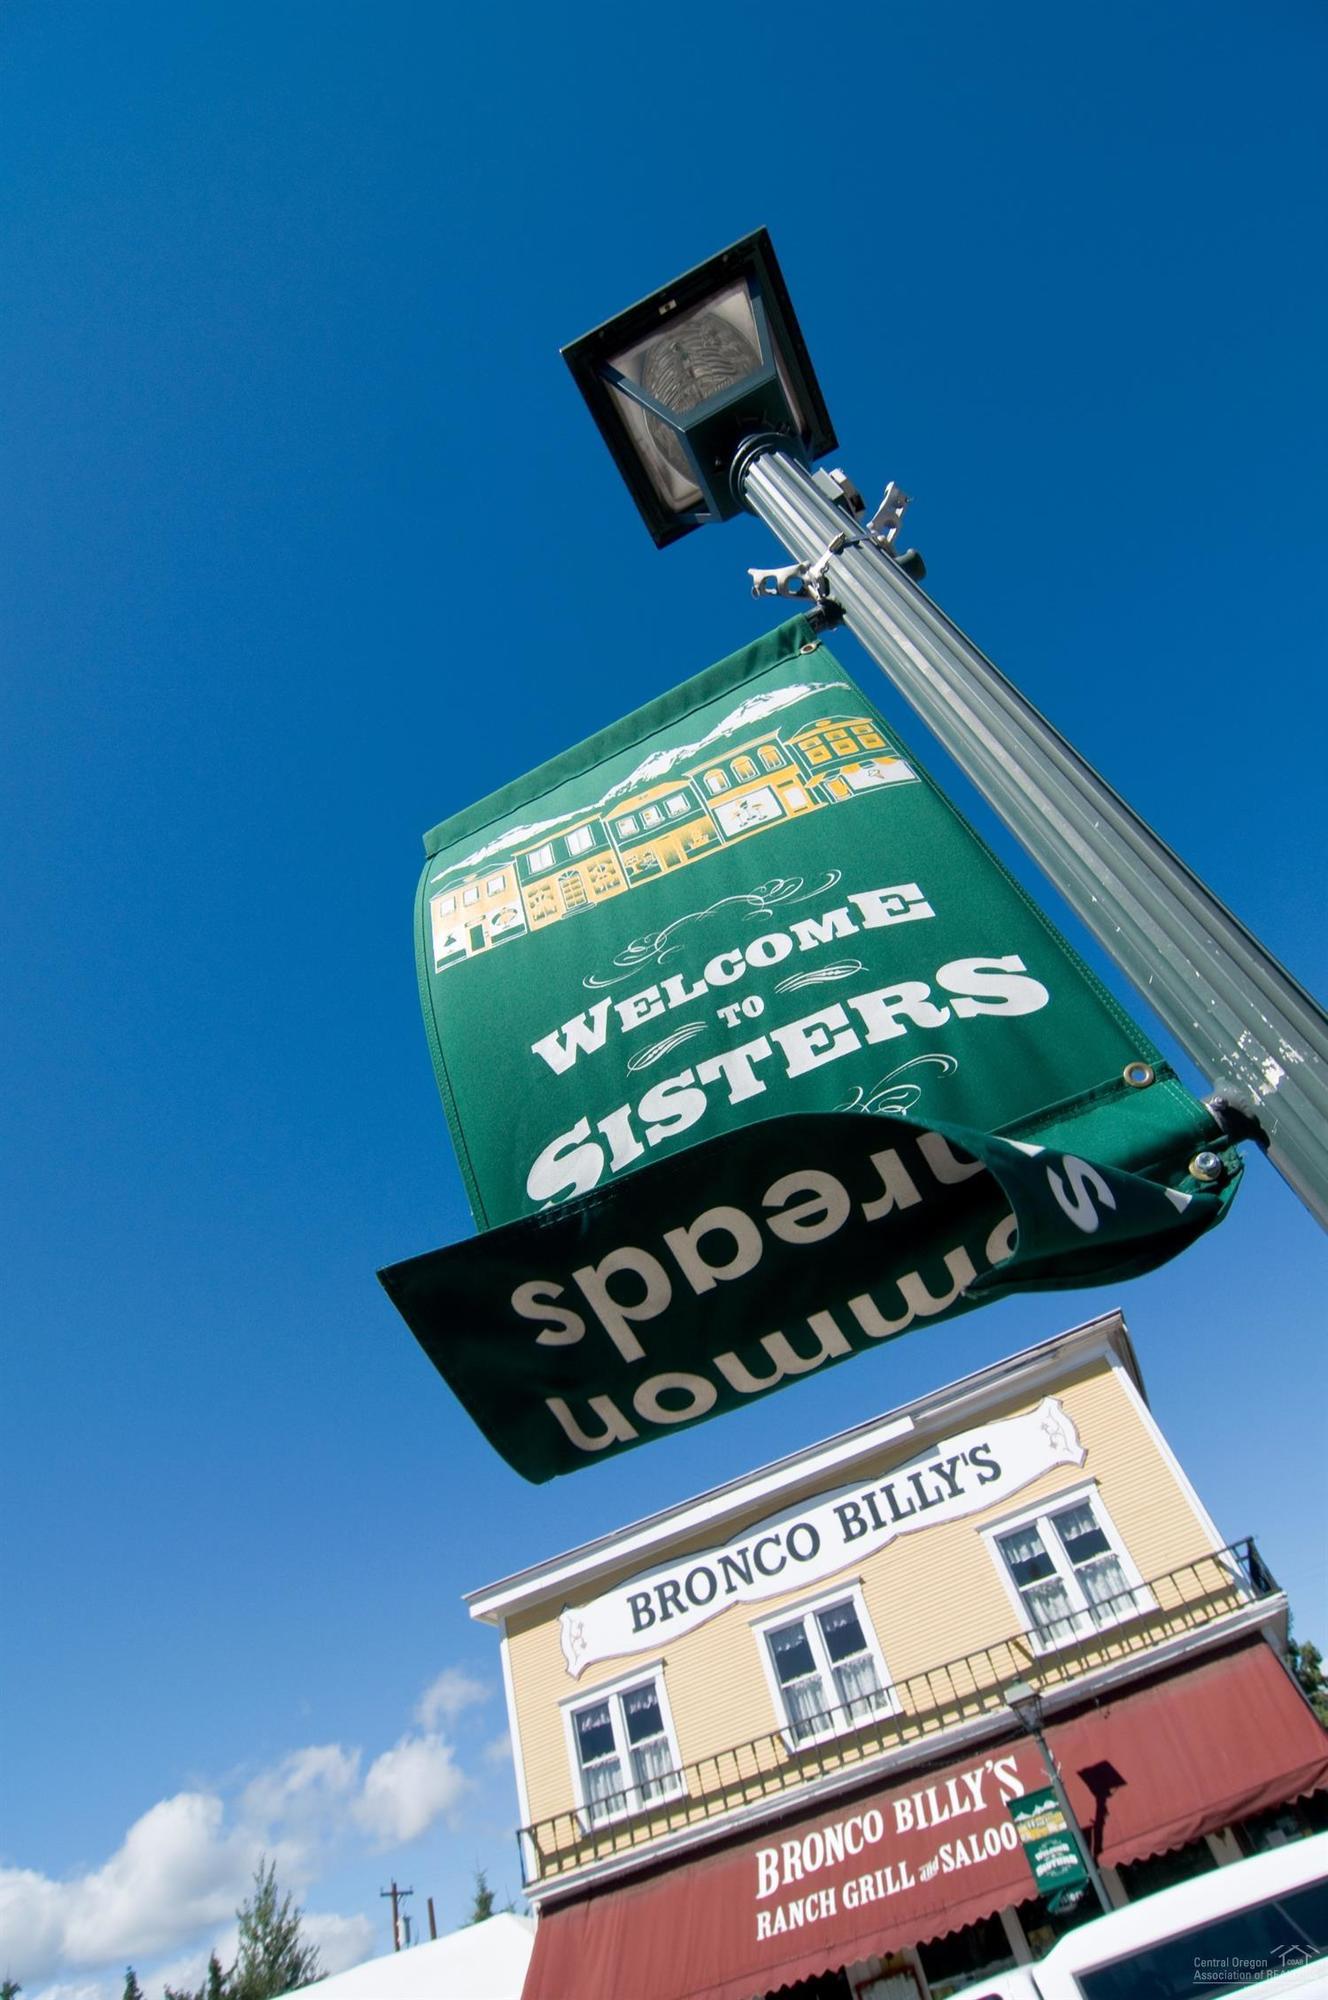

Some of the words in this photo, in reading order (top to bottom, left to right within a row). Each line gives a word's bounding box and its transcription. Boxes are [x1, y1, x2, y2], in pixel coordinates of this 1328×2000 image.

[531, 882, 936, 1076] WELCOME
[717, 993, 766, 1028] TO
[526, 953, 1050, 1211] SISTERS
[627, 1522, 821, 1634] BRONCO
[833, 1443, 1002, 1544] BILLY'S
[755, 1809, 884, 1899] BRONCO
[892, 1755, 1025, 1834] BILLY'S
[755, 1887, 837, 1941] RANCH
[842, 1861, 916, 1910] GRILL
[918, 1855, 940, 1883] and
[938, 1822, 1019, 1874] SALOO
